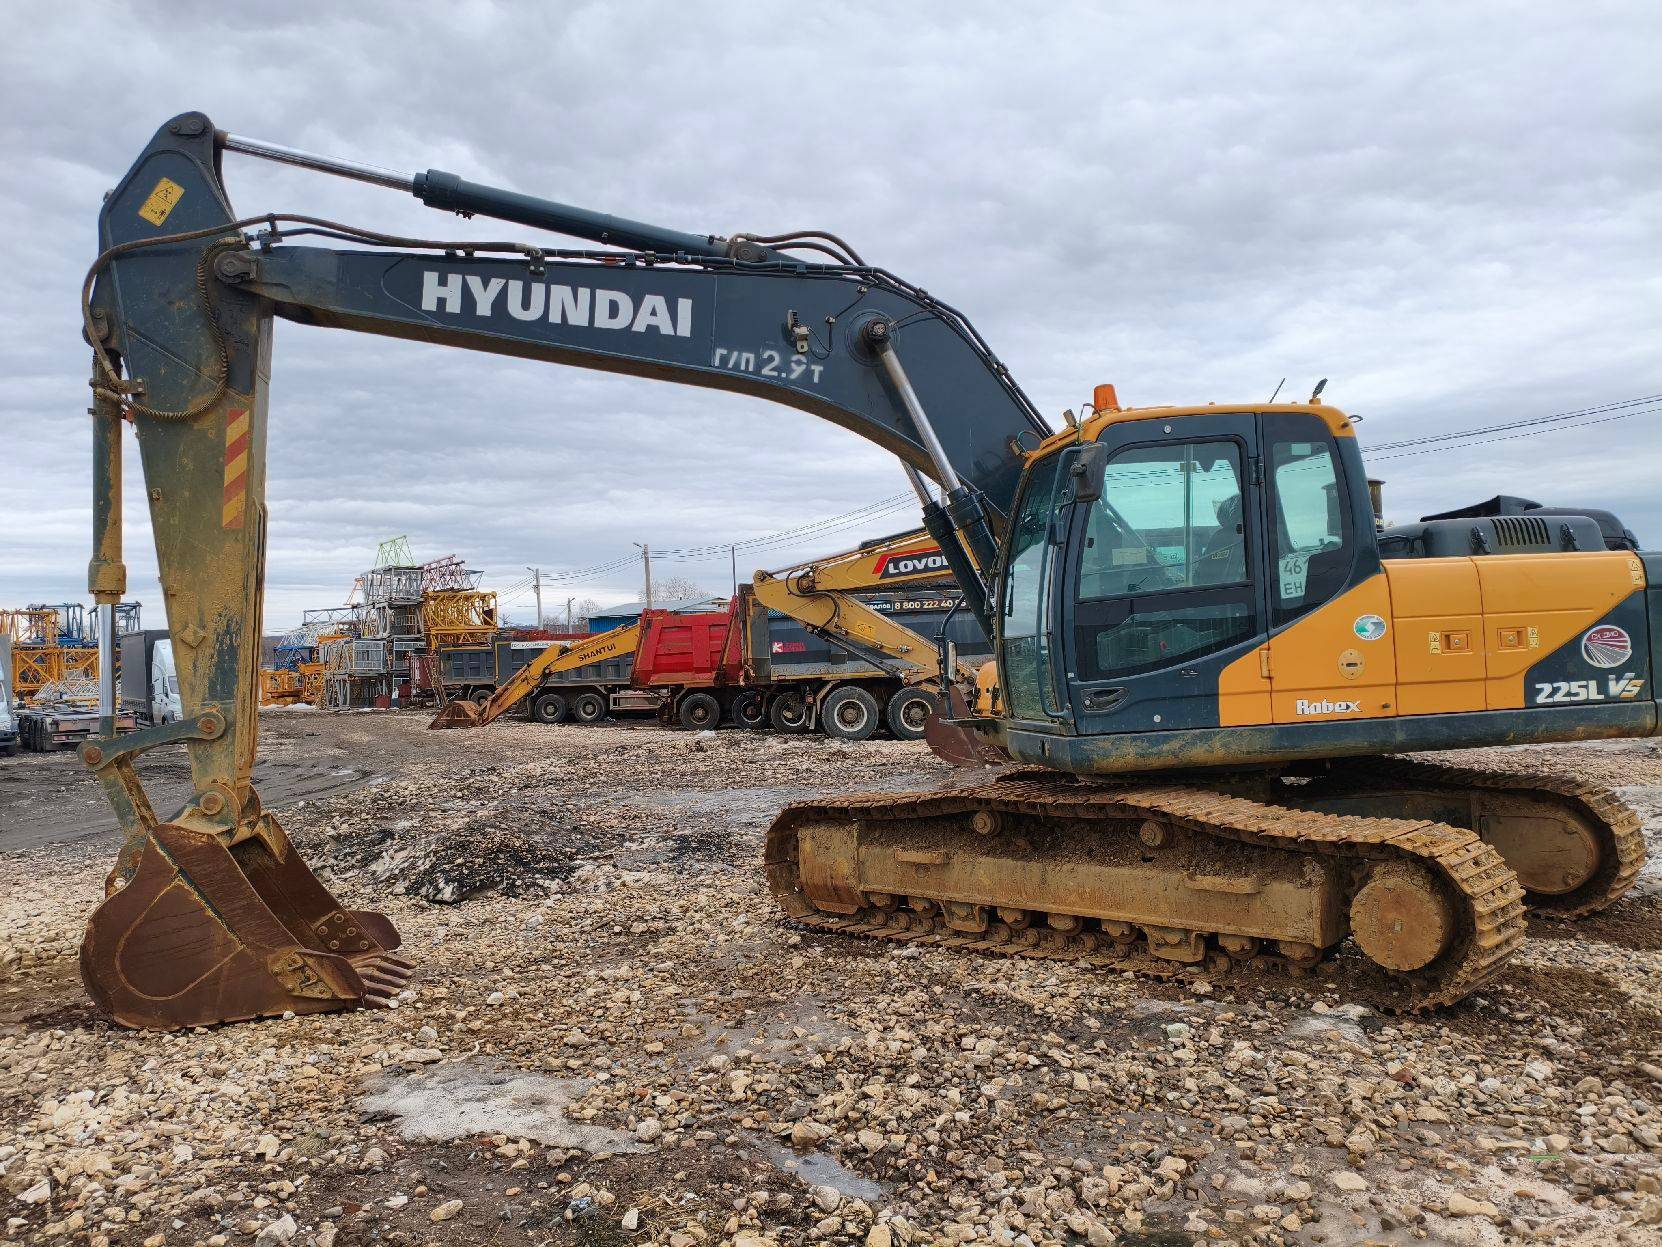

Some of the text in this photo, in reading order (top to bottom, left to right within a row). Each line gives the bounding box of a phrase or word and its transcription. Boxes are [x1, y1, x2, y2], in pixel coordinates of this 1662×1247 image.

[421, 271, 693, 338] HYUNDAI
[1283, 559, 1303, 575] 46
[895, 602, 901, 610] 8
[902, 601, 921, 609] 800
[922, 600, 940, 609] 222
[578, 643, 617, 662] SHANTUI
[1535, 679, 1605, 704] 225L
[1296, 698, 1362, 715] Robex
